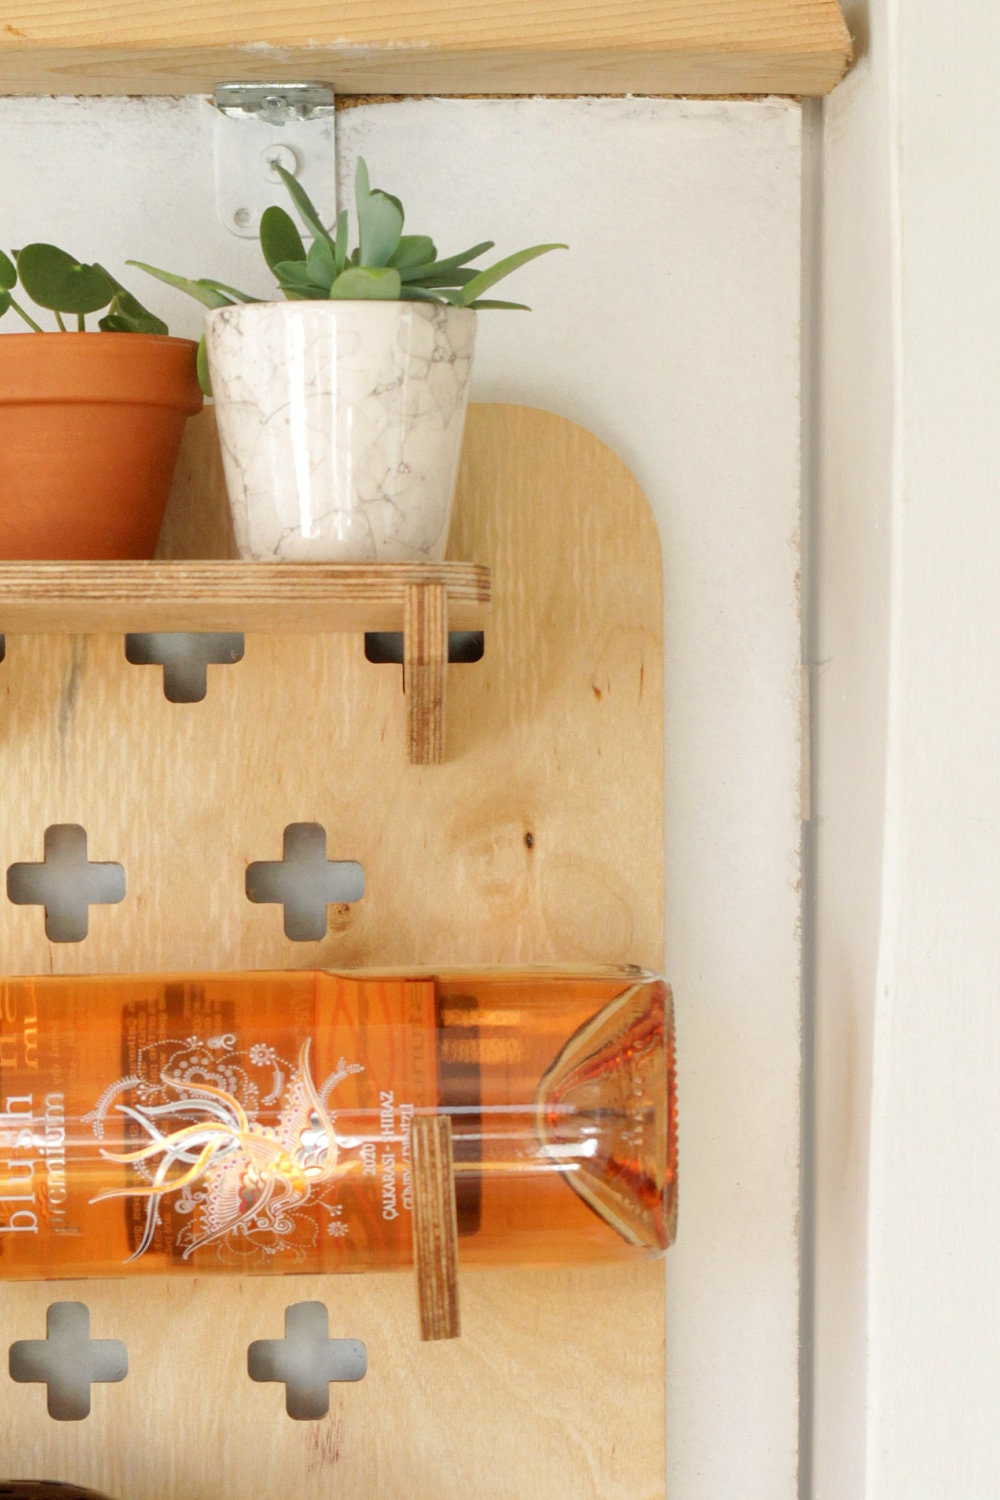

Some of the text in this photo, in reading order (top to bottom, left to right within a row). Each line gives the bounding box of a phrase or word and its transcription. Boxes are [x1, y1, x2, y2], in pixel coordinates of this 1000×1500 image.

[380, 1090, 395, 1143] SHIRAZ
[40, 1092, 77, 1235] premium
[361, 1143, 376, 1176] 2020
[382, 1153, 400, 1220] ÇALKARASI
